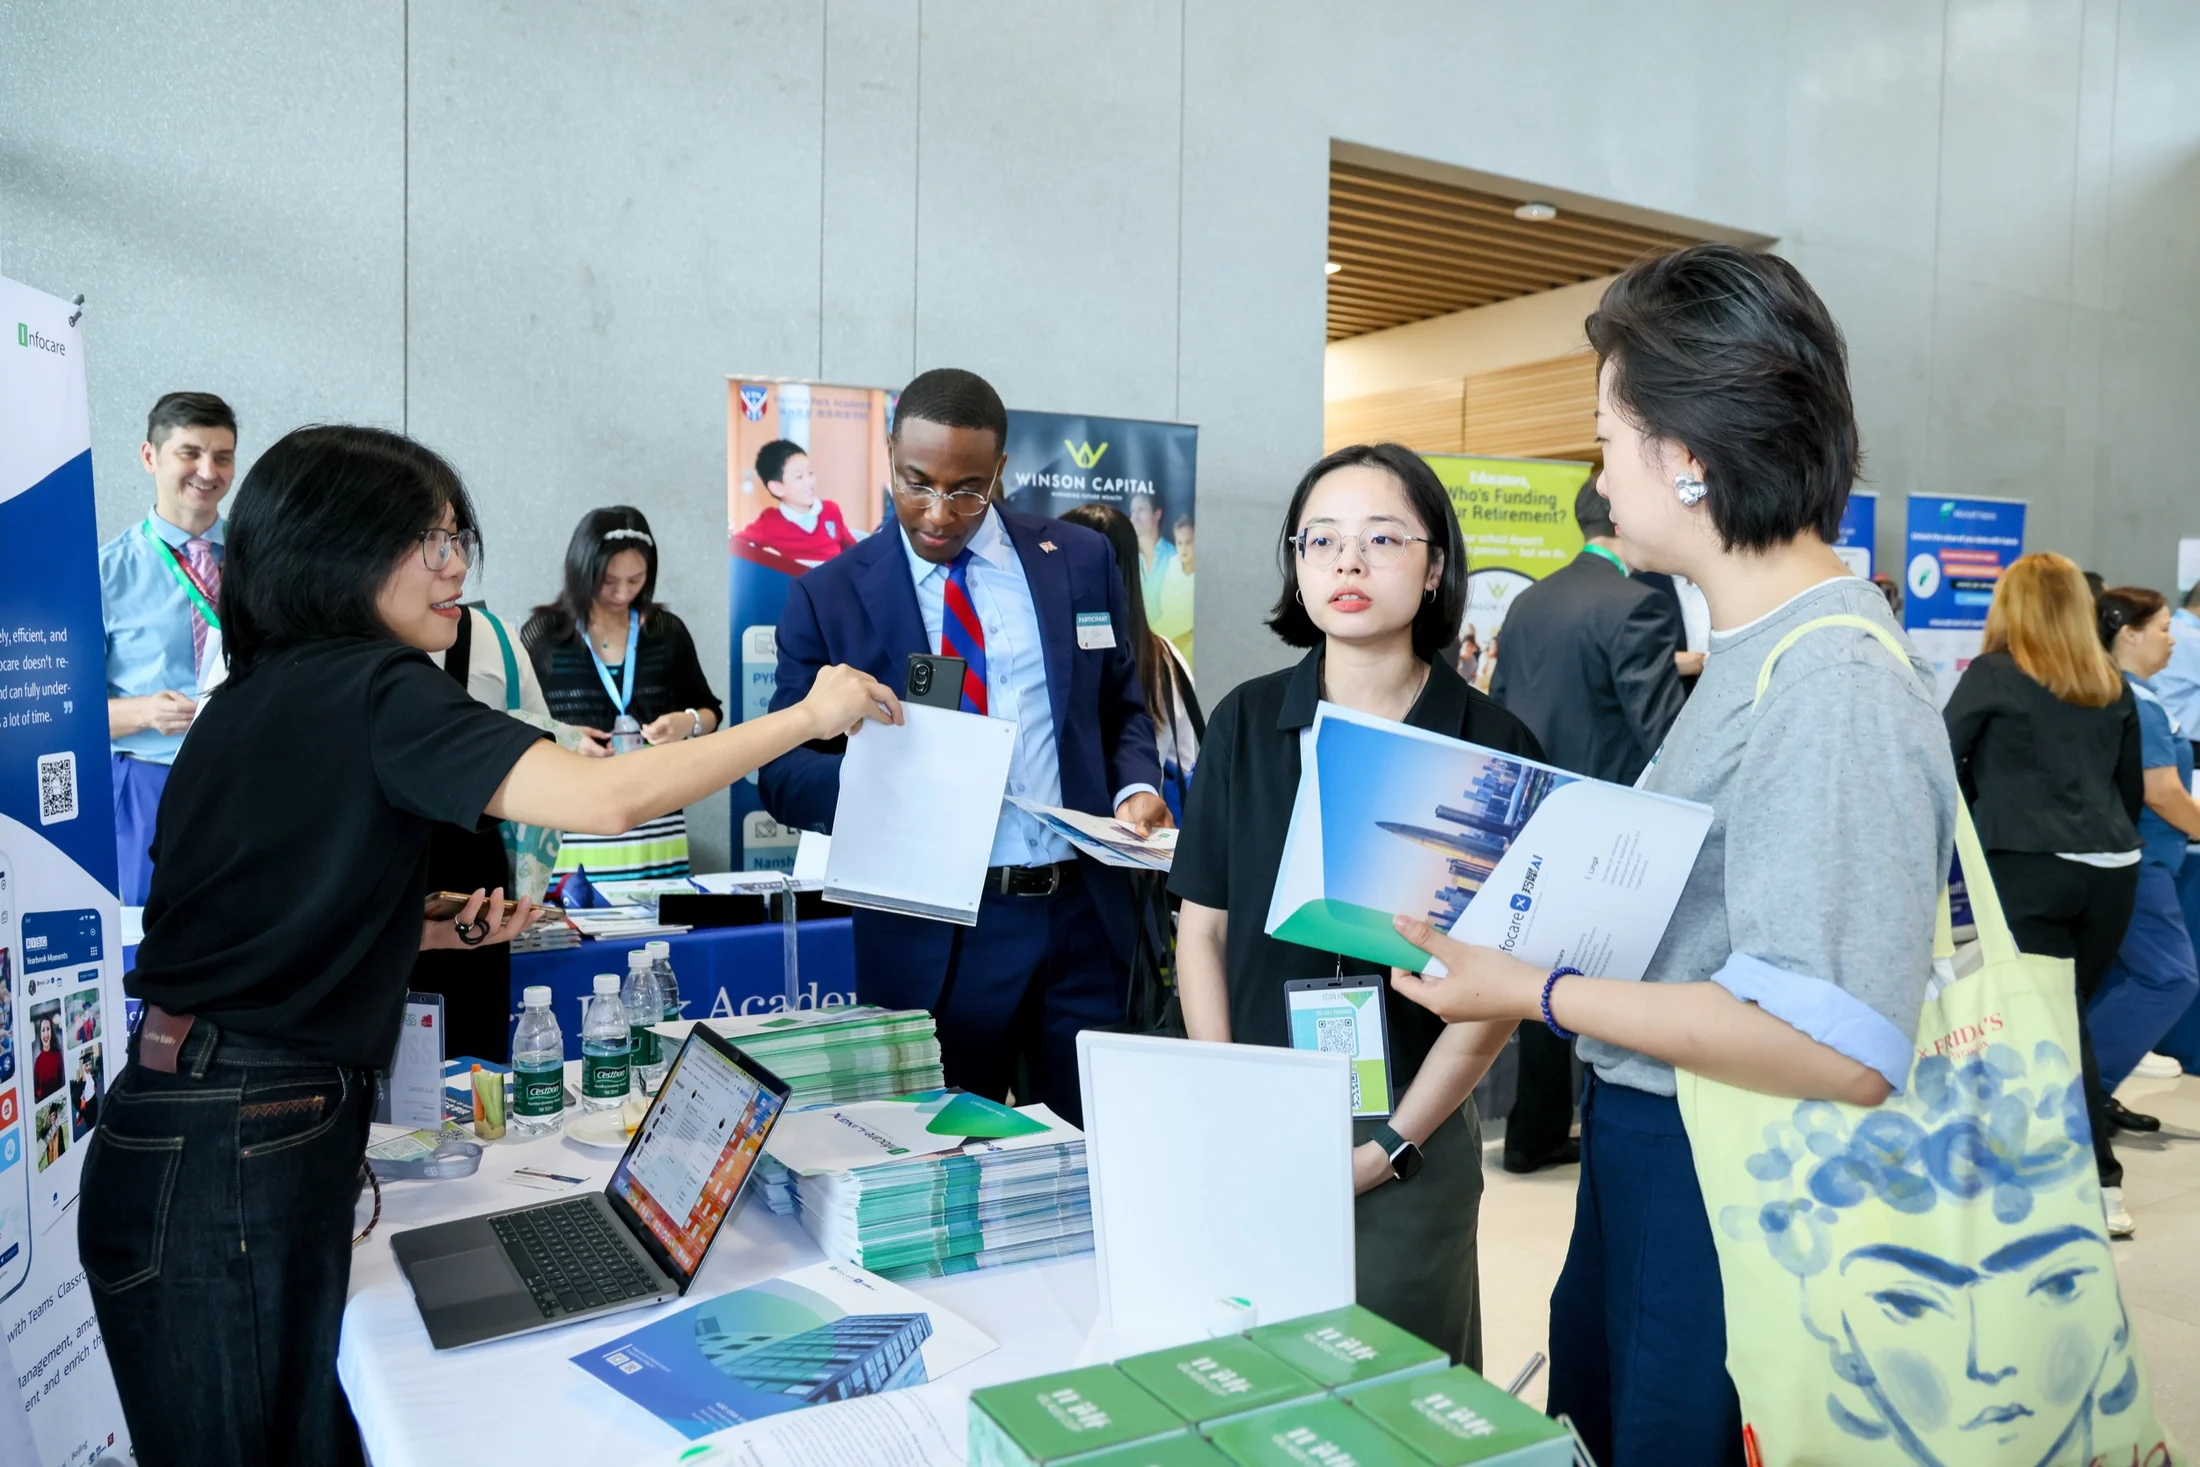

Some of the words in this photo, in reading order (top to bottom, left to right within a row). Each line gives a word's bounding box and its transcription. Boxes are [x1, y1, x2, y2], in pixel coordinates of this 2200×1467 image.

[18, 322, 66, 356] Infocare
[1015, 472, 1086, 490] WINSON
[1092, 477, 1156, 495] CAPITAL
[1494, 487, 1557, 509] Funding
[1472, 504, 1567, 524] Retirement?
[12, 627, 47, 645] efficient,
[49, 627, 68, 642] and
[22, 654, 53, 670] doesn't
[56, 657, 69, 668] re-
[9, 687, 23, 699] can
[24, 682, 40, 700] fully
[41, 680, 71, 696] under-
[2, 717, 8, 728] a
[9, 712, 20, 727] lot
[21, 709, 32, 725] of
[31, 709, 53, 724] time.
[1498, 911, 1525, 954] focare
[26, 954, 47, 965] Yearbook
[47, 952, 68, 963] Moments
[709, 981, 858, 1018] Acade
[1322, 992, 1337, 1001] SCAN
[6, 1317, 27, 1343] with
[28, 1294, 54, 1325] Teams
[43, 1369, 61, 1395] and
[63, 1345, 90, 1377] enrich
